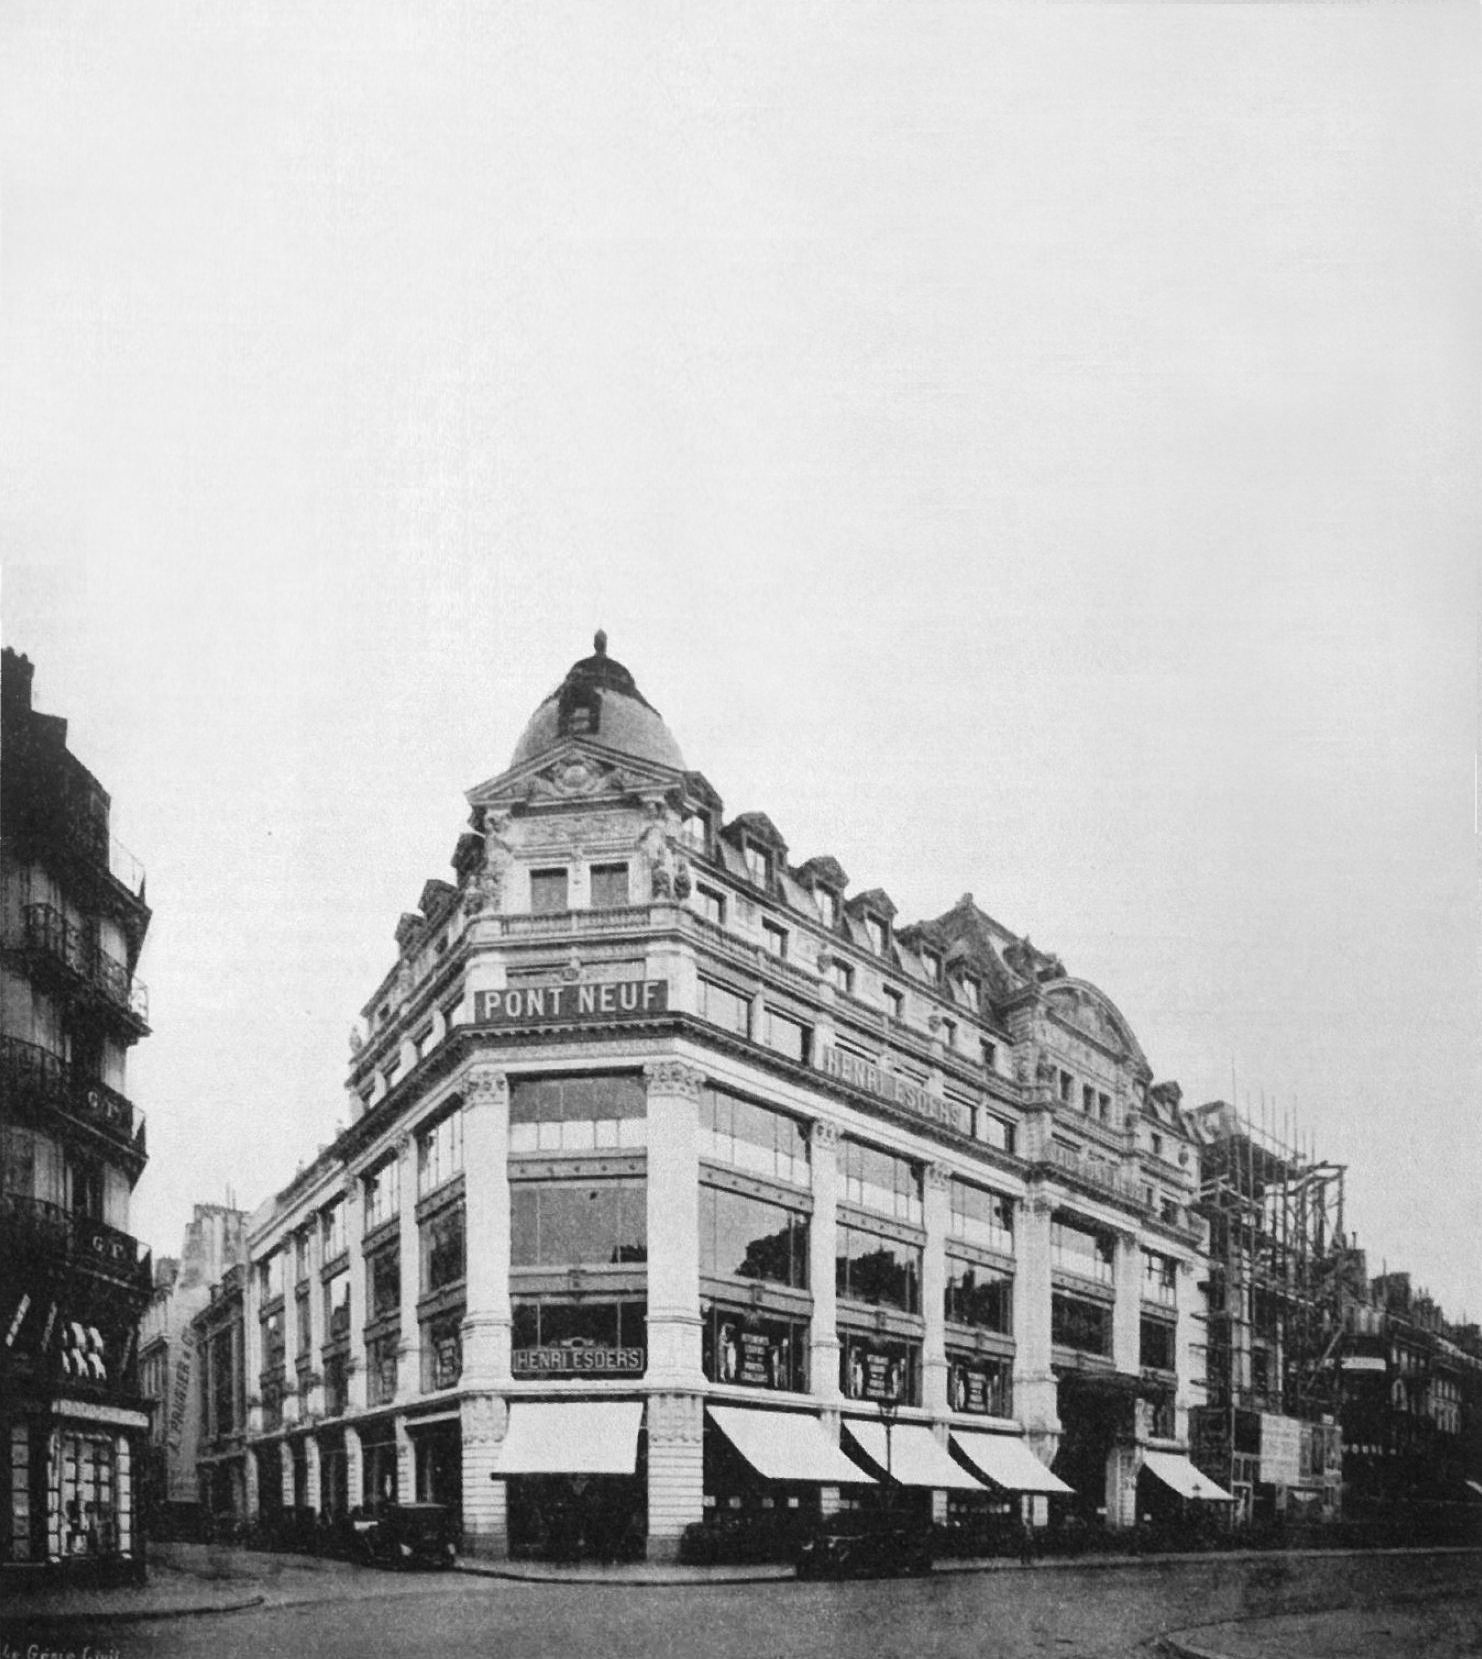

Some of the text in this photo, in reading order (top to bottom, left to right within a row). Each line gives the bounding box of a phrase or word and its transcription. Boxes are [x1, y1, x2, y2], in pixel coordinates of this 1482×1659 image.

[483, 981, 659, 1019] PONT NEUF
[823, 1045, 962, 1127] HENRI ESDERS
[517, 1351, 639, 1369] HENRI ESDERS
